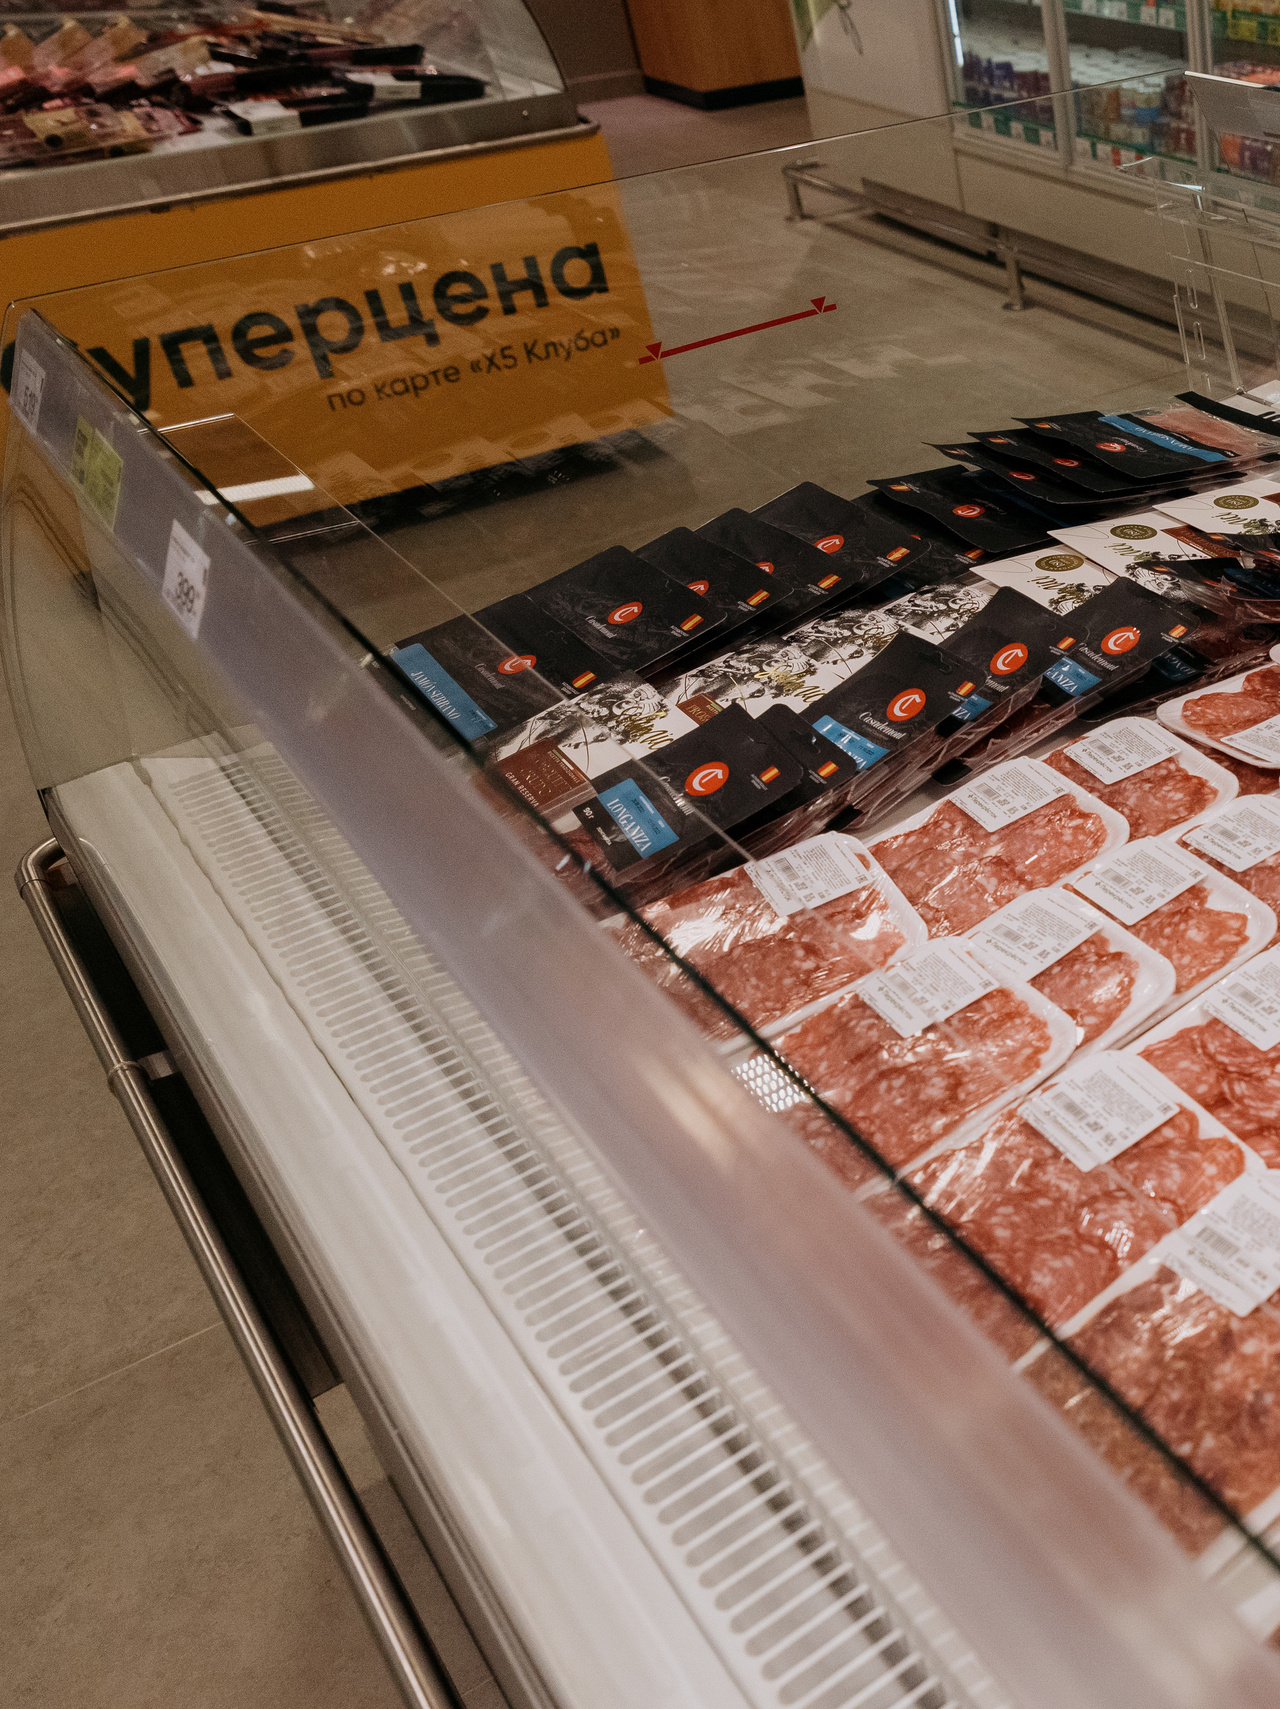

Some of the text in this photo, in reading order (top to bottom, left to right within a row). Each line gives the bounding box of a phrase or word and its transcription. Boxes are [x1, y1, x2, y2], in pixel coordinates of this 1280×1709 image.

[327, 383, 366, 412] по
[374, 359, 461, 400] карте
[525, 326, 621, 371] Клуба»
[859, 711, 907, 740] Casademont
[518, 785, 541, 808] RESERVA
[606, 798, 653, 852] LONGANIZA
